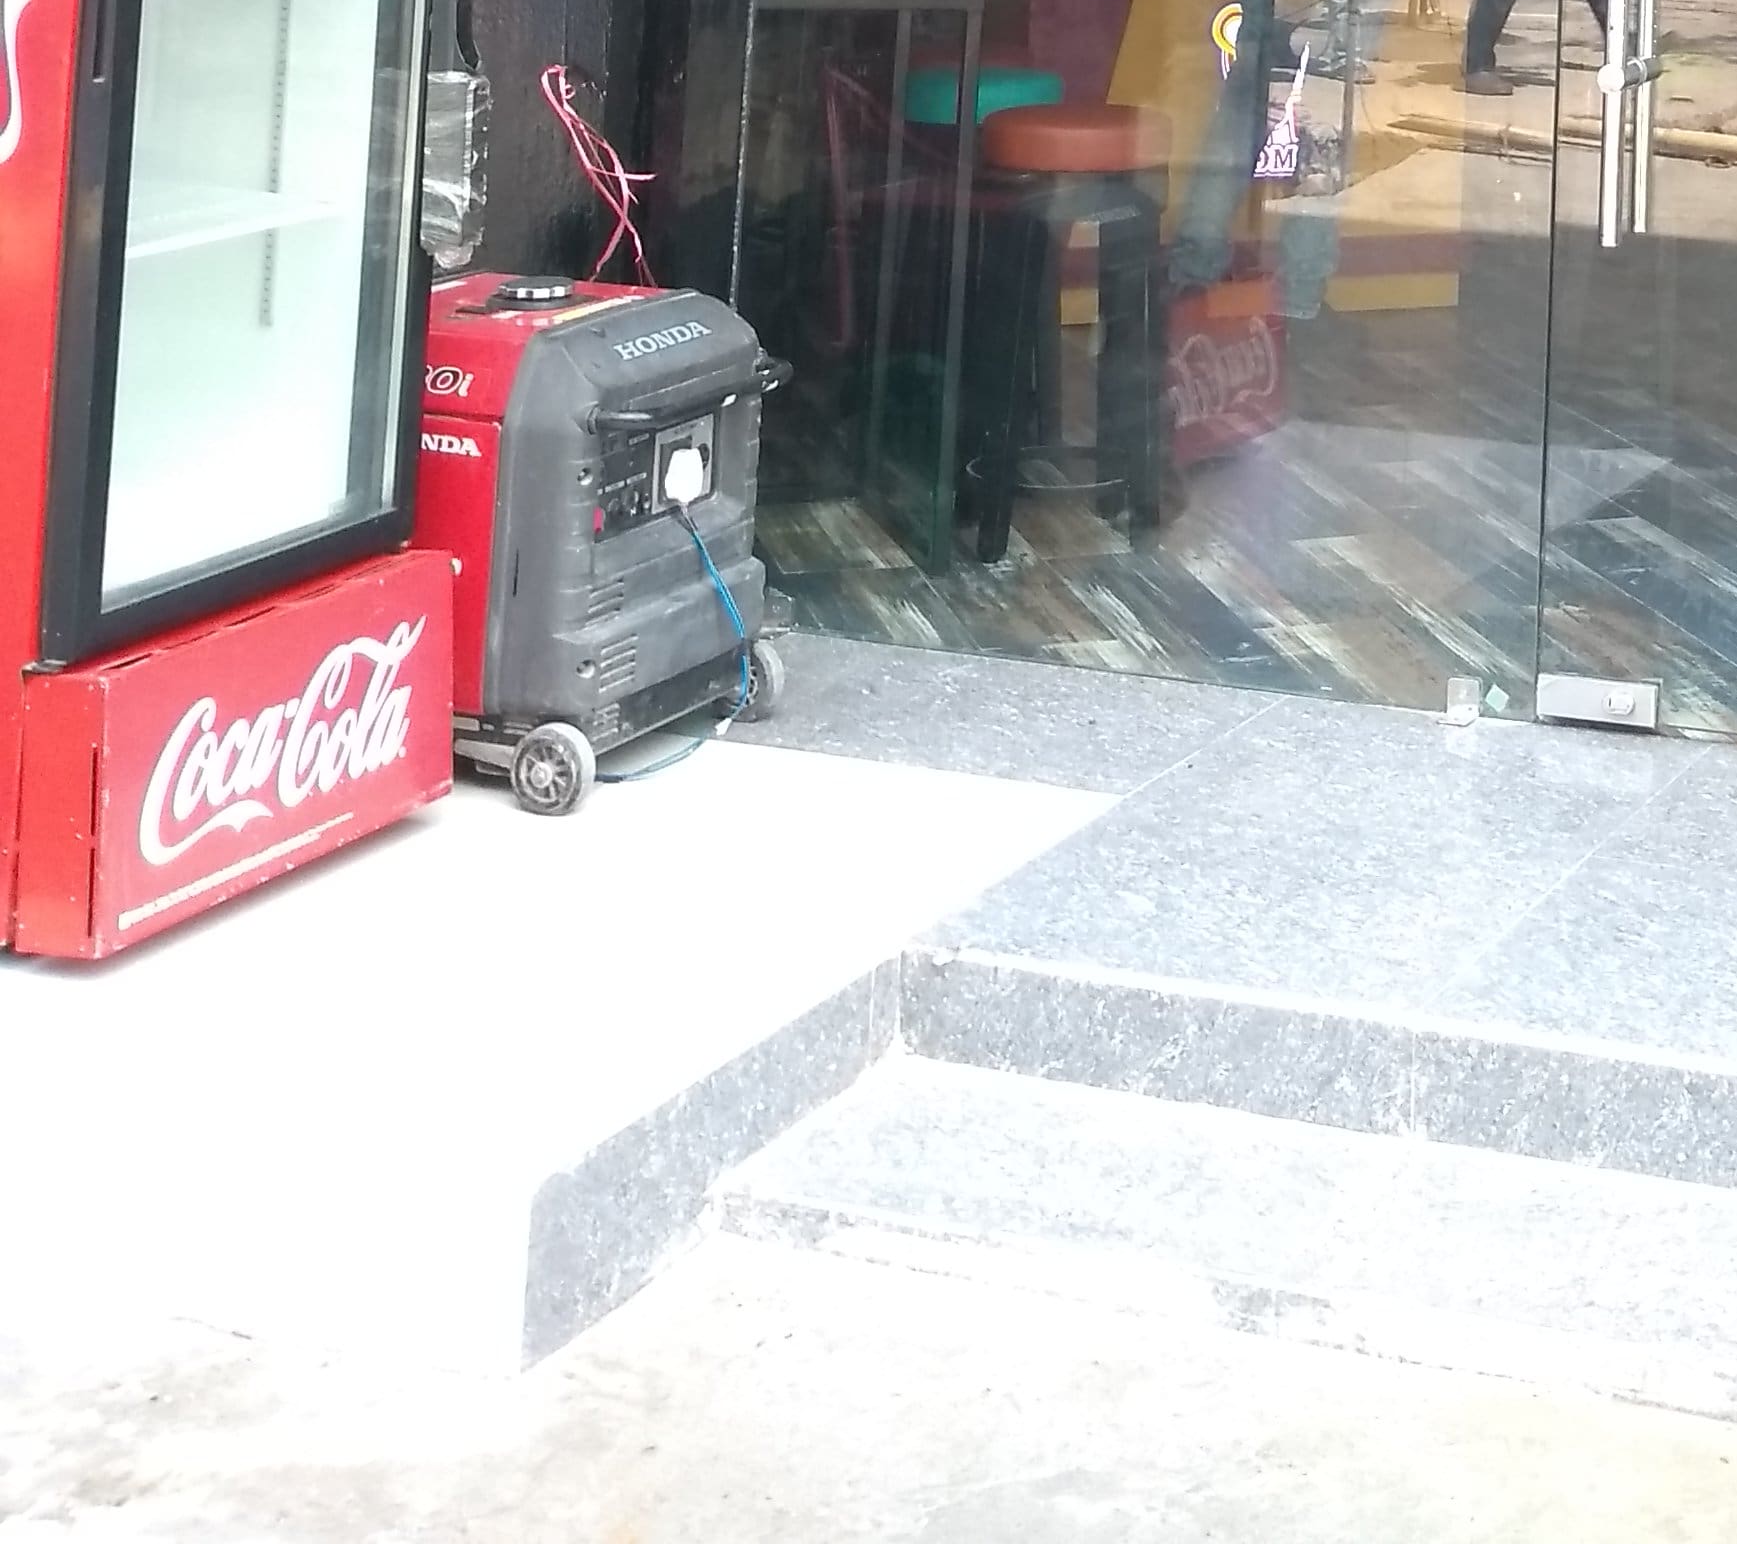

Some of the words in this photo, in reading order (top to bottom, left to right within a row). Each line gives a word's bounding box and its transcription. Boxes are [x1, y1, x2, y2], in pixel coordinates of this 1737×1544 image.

[612, 320, 713, 361] HONDA
[420, 432, 482, 458] NDA
[136, 612, 428, 868] Coca-Cola
